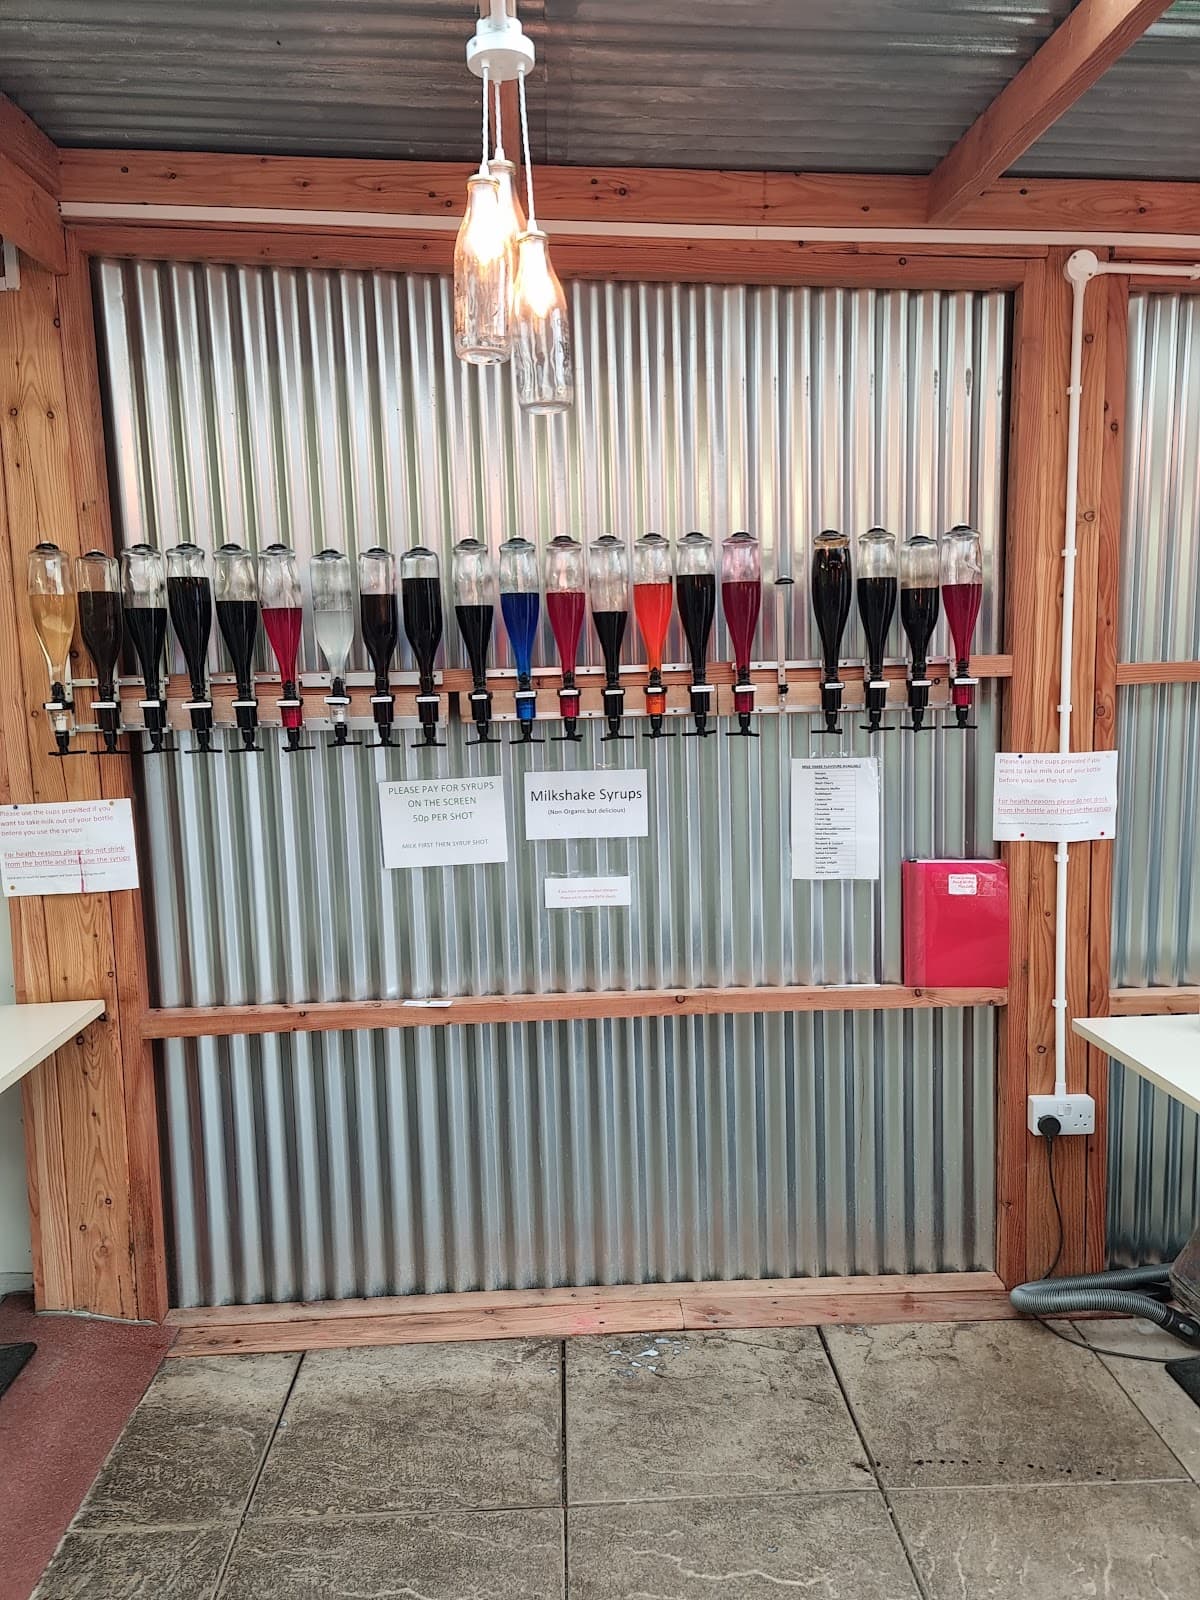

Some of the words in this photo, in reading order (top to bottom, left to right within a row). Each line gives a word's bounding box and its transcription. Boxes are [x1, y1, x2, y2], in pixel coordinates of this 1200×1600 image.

[388, 785, 420, 795] PLEASE
[422, 784, 439, 793] PAY
[441, 783, 459, 792] FOR
[461, 781, 494, 791] SYRUPS
[530, 788, 596, 802] Milkshake
[599, 788, 642, 802] Syrups
[407, 799, 421, 808] ON
[424, 798, 441, 807] THE
[442, 796, 477, 806] SCREEN
[412, 814, 430, 823] 50p
[431, 812, 448, 822] PER
[450, 811, 473, 821] SHOT
[563, 808, 585, 816] Organic
